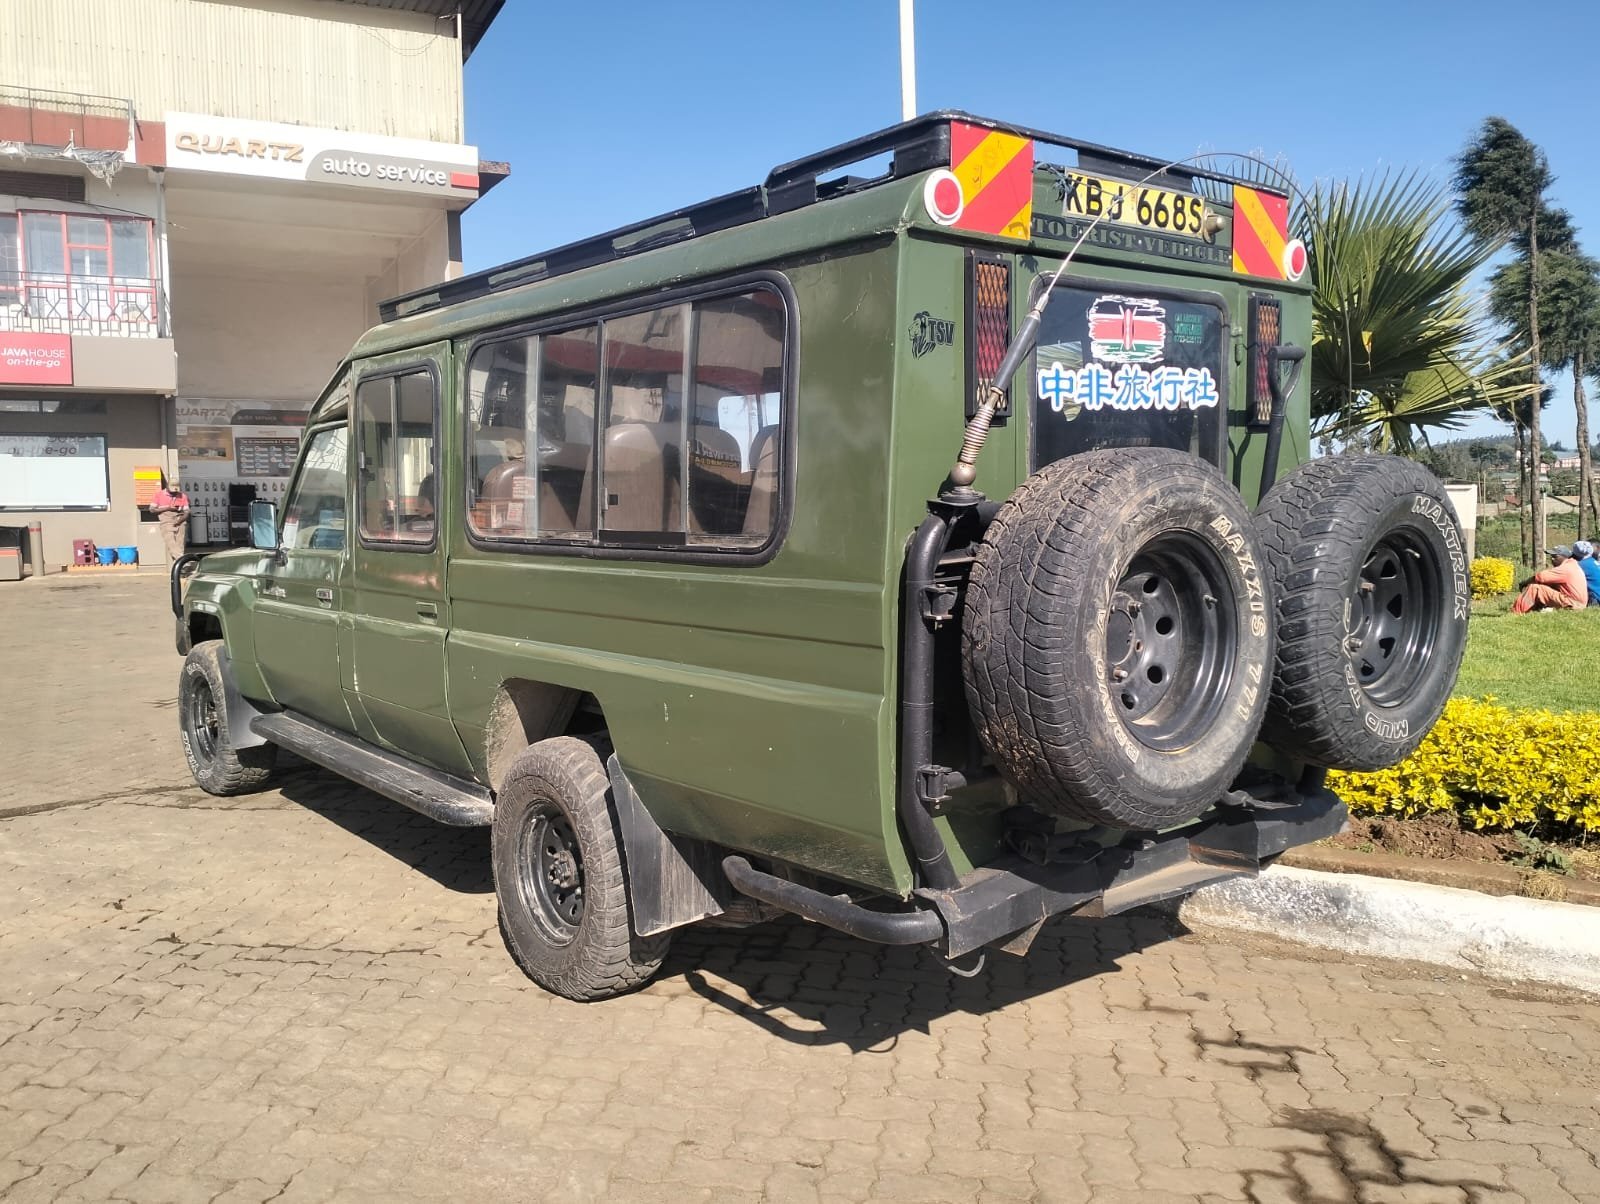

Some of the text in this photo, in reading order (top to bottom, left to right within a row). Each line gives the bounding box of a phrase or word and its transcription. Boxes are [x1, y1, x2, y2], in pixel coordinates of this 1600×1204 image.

[175, 131, 447, 186] QUARTZ auto service
[1065, 174, 1202, 233] KBJ 668S
[1031, 217, 1230, 265] TOURIST VEHICLE
[1, 347, 65, 359] JAVA HOUSE
[928, 320, 956, 346] TSV
[7, 358, 60, 368] on-the-go
[1038, 362, 1219, 412] 中非旅行社
[1411, 496, 1467, 621] MAXTREK
[1210, 513, 1266, 721] MAXXIS 771
[1343, 597, 1409, 739] MUD TRA
